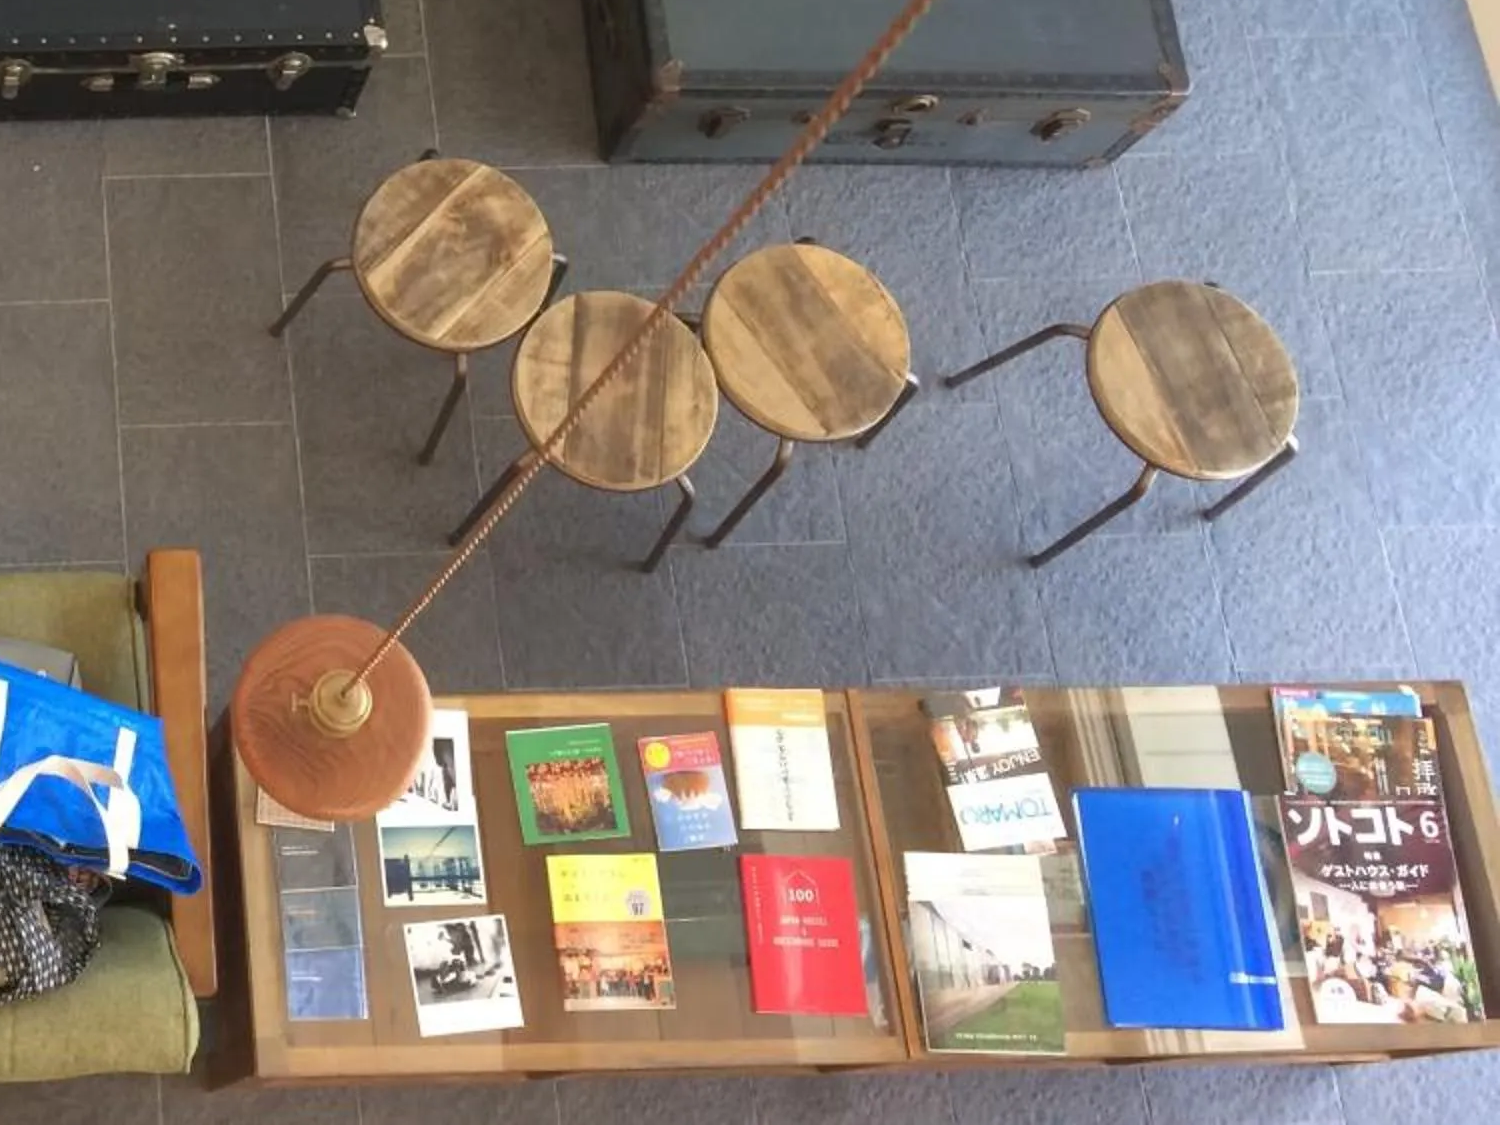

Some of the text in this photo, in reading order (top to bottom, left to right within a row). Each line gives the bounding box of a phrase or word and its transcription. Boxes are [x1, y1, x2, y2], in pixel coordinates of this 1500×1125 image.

[1287, 806, 1415, 846] ソトコト
[1419, 810, 1440, 838] 6
[1320, 864, 1429, 878] ゲストハウス・ガイド
[787, 888, 815, 903] 100
